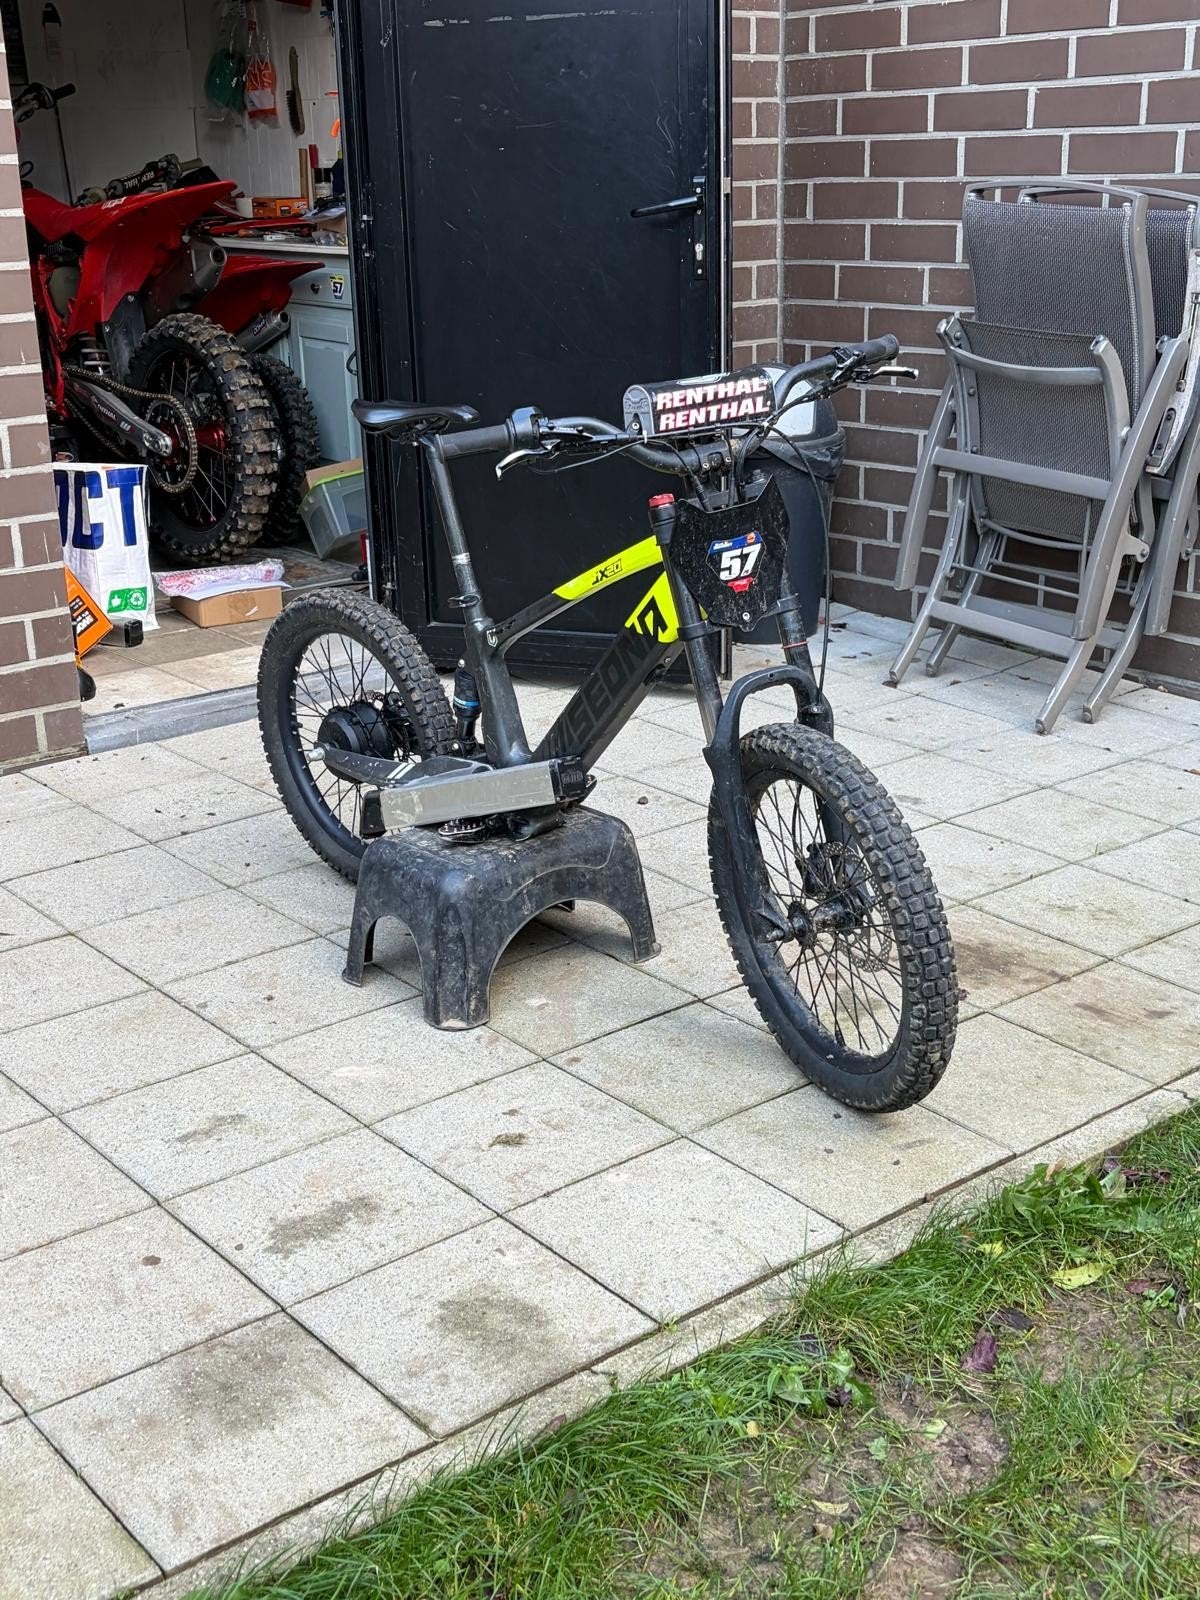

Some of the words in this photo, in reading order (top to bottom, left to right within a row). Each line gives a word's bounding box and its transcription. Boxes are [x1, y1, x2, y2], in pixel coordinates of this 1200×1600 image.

[656, 376, 768, 411] RENTHAL
[659, 396, 770, 431] RENTHAL
[720, 543, 761, 580] 57
